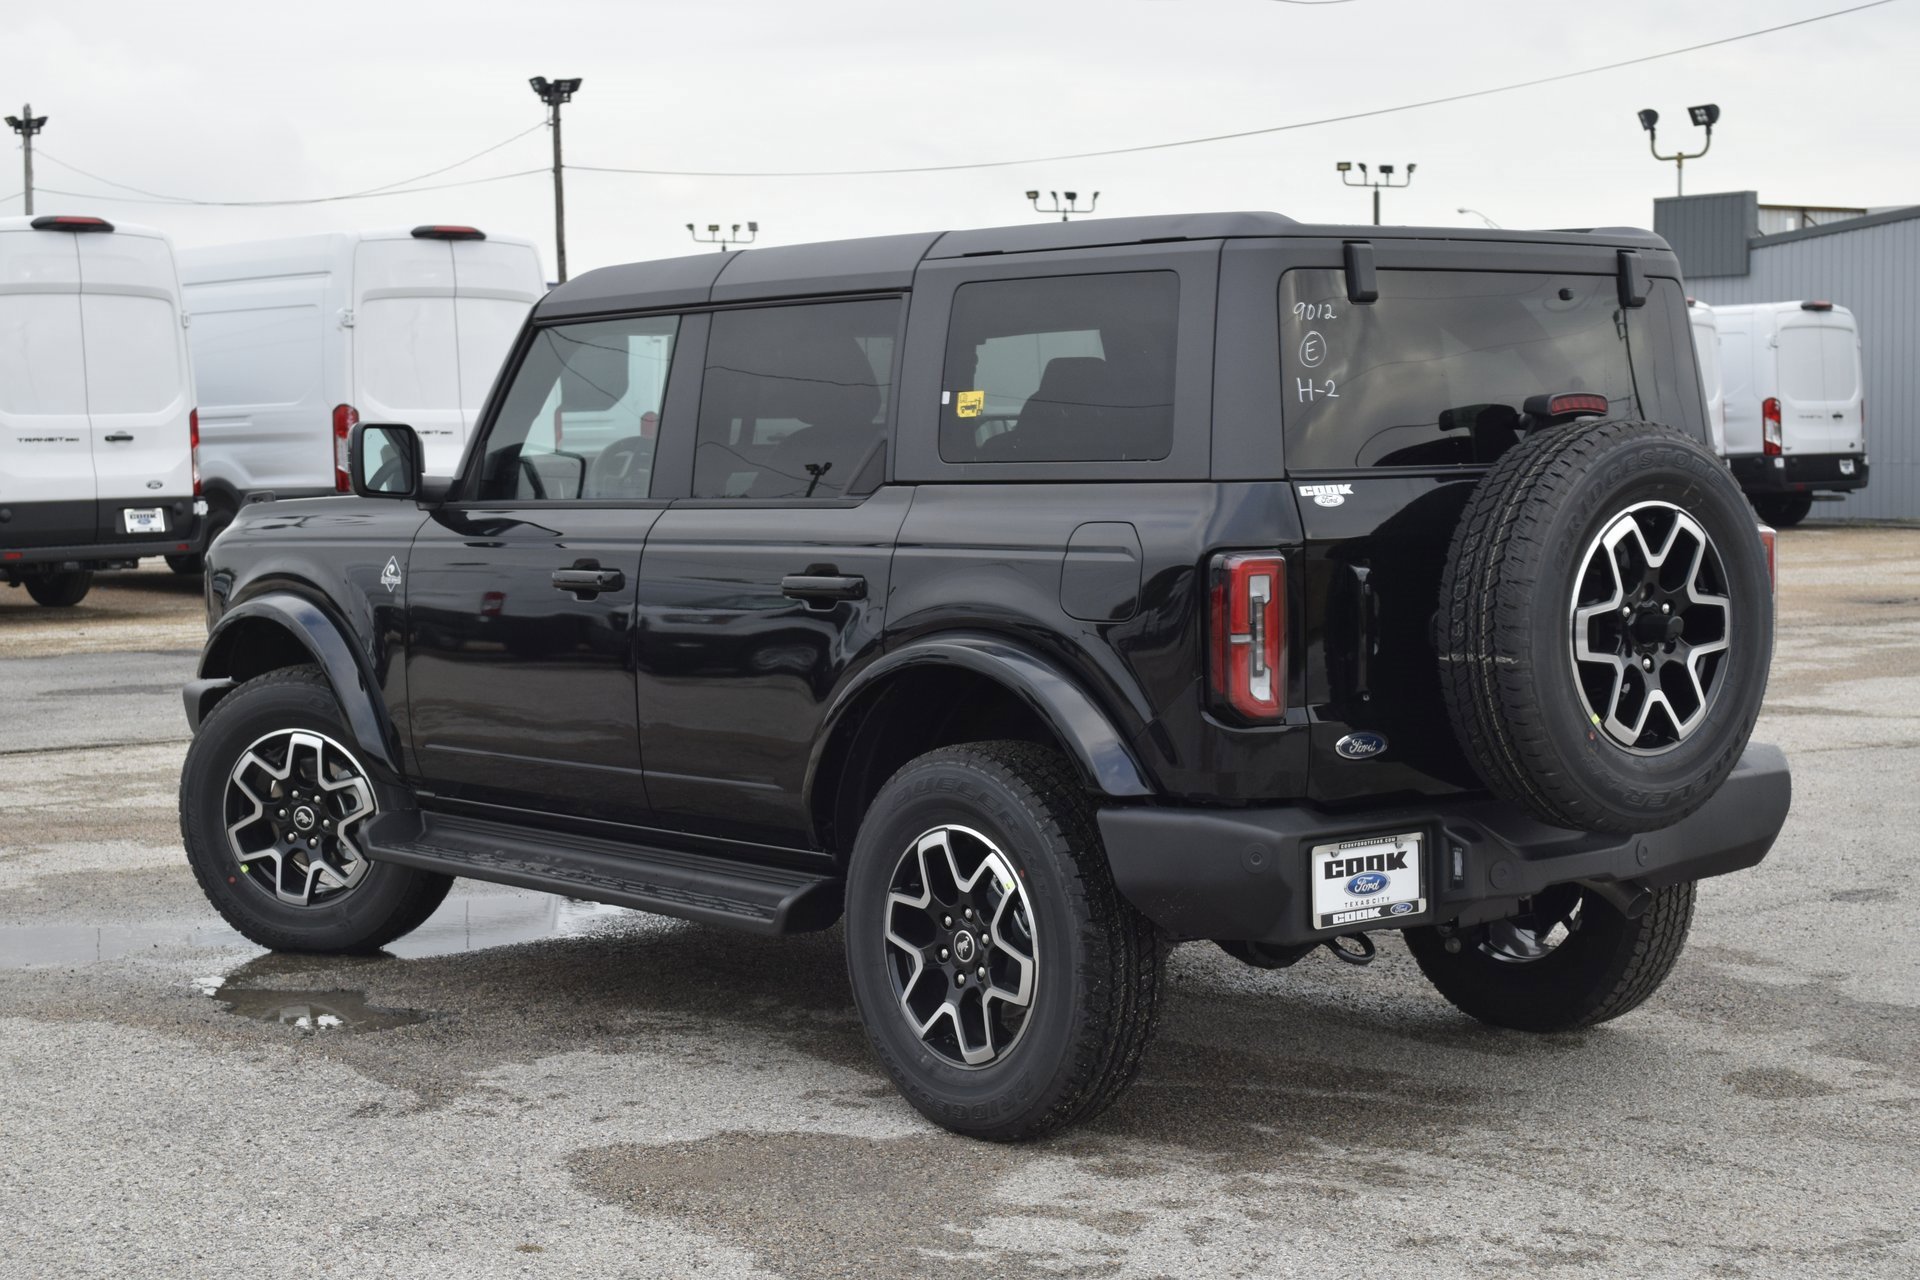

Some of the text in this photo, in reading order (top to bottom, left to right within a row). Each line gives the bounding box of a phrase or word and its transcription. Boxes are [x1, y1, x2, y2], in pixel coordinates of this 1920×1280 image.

[1293, 302, 1337, 320] 9012
[1296, 377, 1340, 403] H-2
[1298, 484, 1354, 497] COOK
[1349, 738, 1376, 754] Ford
[1324, 851, 1408, 880] COOK
[1354, 876, 1380, 893] Ford
[1345, 896, 1390, 908] TEXAS CITY
[1332, 907, 1382, 925] COOK
